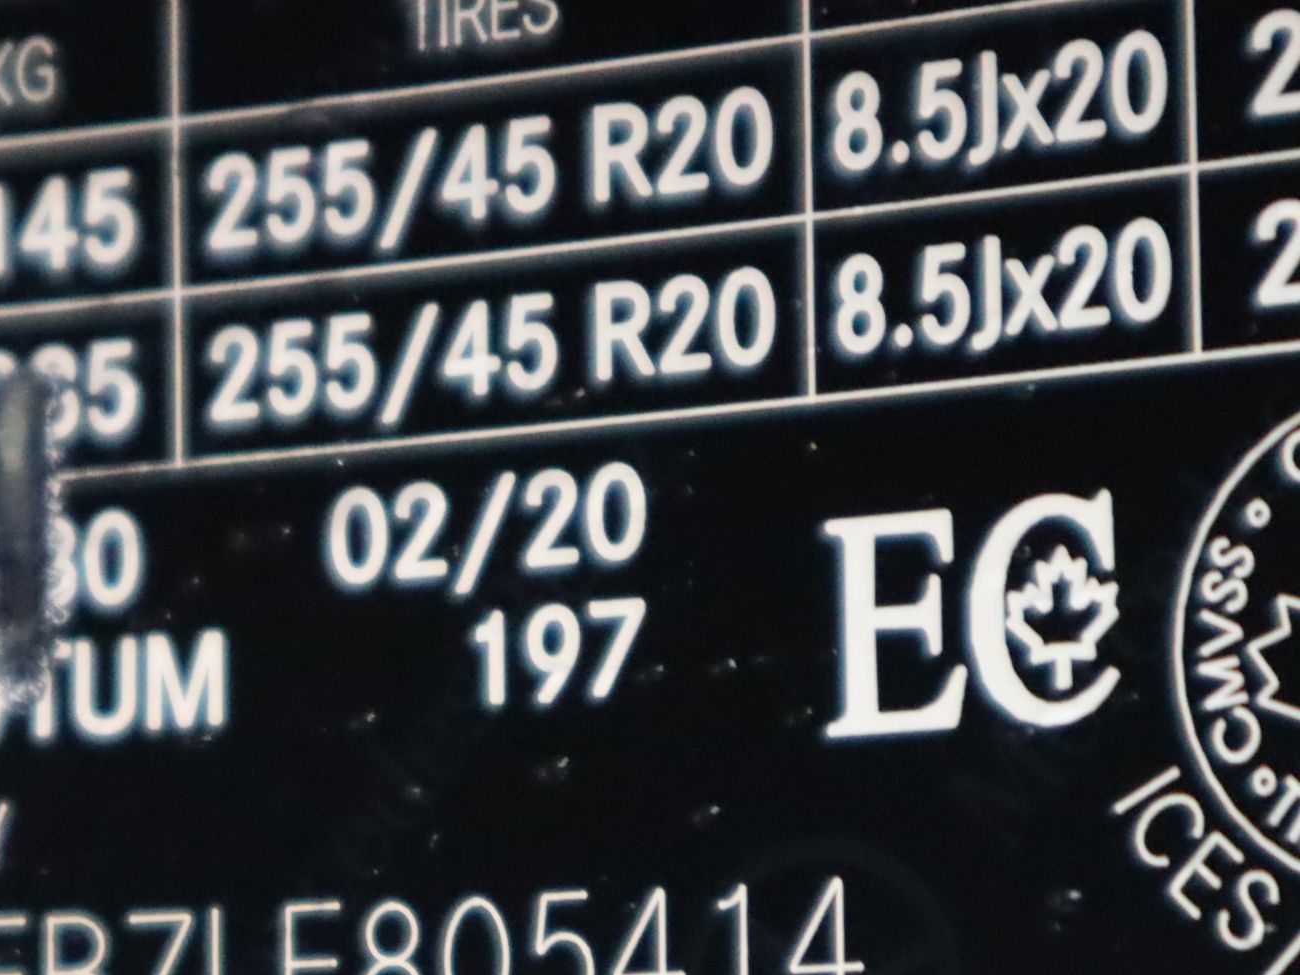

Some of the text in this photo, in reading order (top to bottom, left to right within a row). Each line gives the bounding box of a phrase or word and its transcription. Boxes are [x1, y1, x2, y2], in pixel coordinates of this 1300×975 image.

[206, 85, 773, 253] 255/45 R20
[834, 29, 1168, 172] 8.5Jx20
[208, 265, 776, 425] 255/45 R20
[836, 217, 1172, 355] 8.5Jx20
[328, 462, 646, 595] 02/20
[474, 597, 646, 706] 197
[1199, 536, 1261, 764] CMVSS
